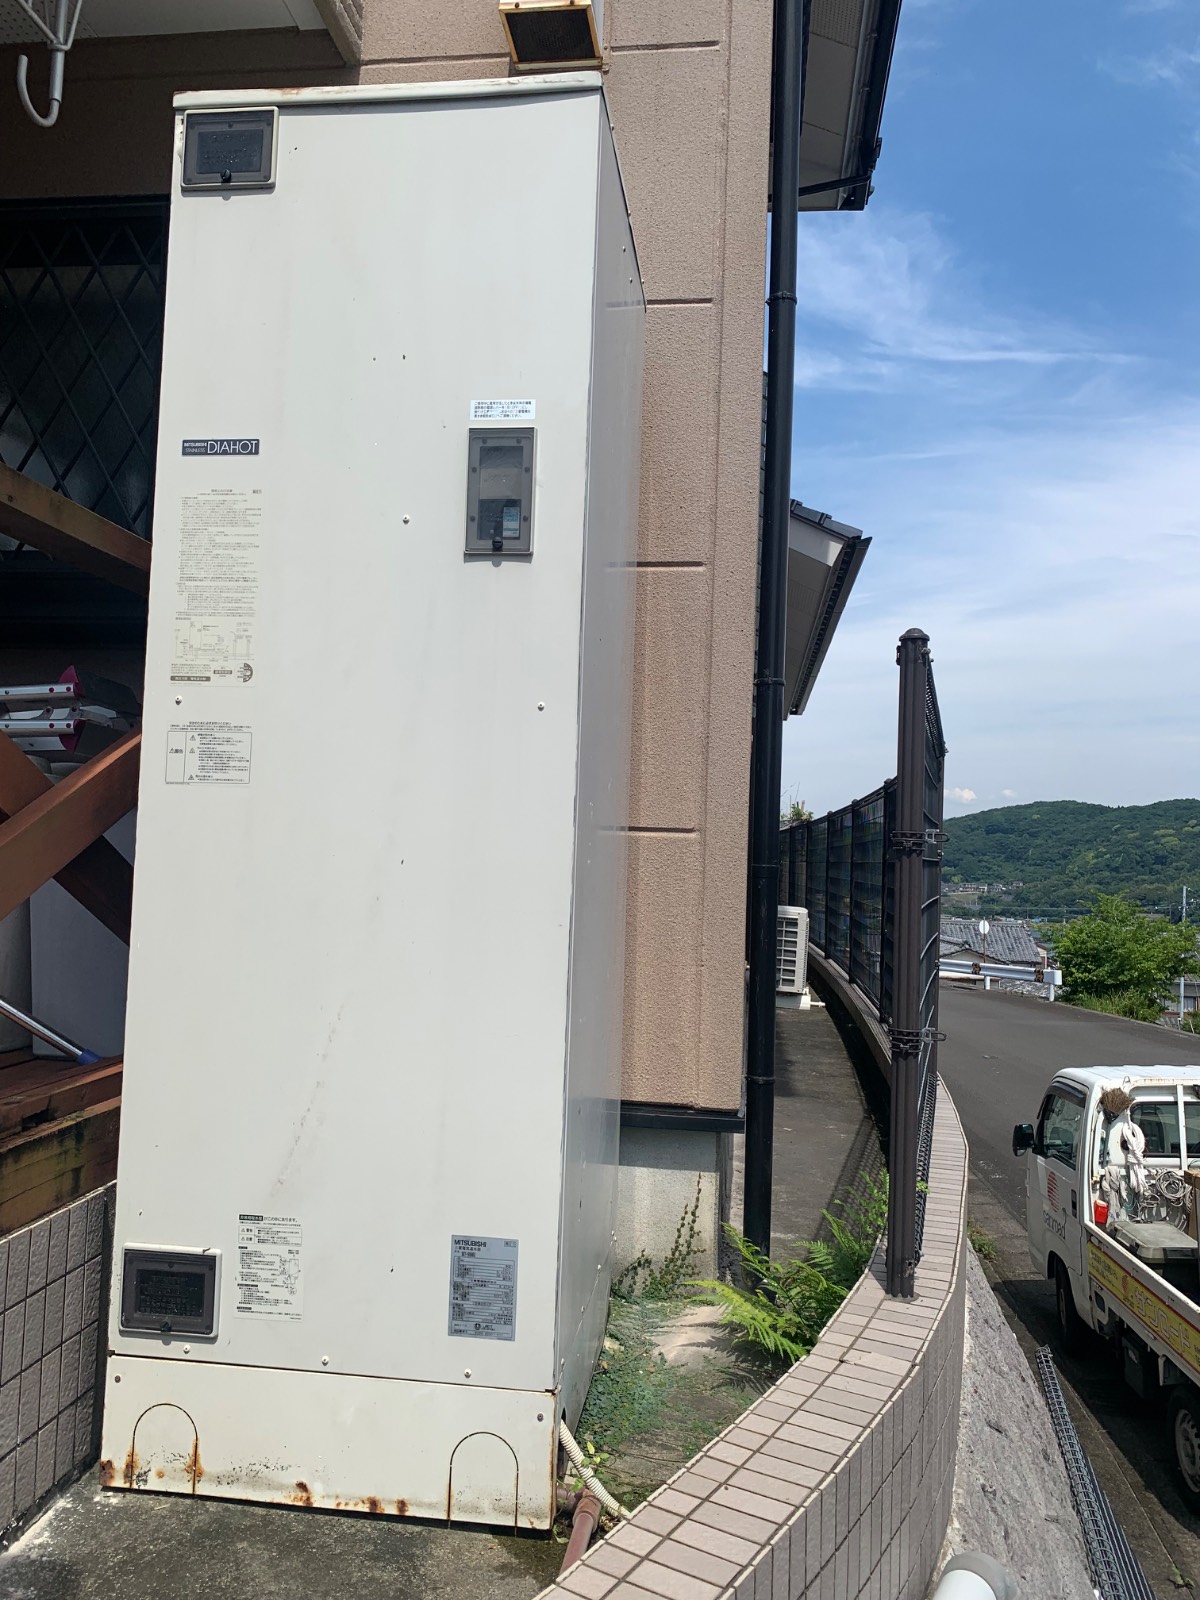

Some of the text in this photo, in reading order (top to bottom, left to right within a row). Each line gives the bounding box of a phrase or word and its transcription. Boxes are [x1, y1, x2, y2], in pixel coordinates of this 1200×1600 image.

[207, 440, 258, 454] DIAHOT
[1042, 1208, 1066, 1240] sanroad
[454, 1240, 486, 1248] MITSUBISHI
[1134, 1286, 1191, 1353] サンロード
